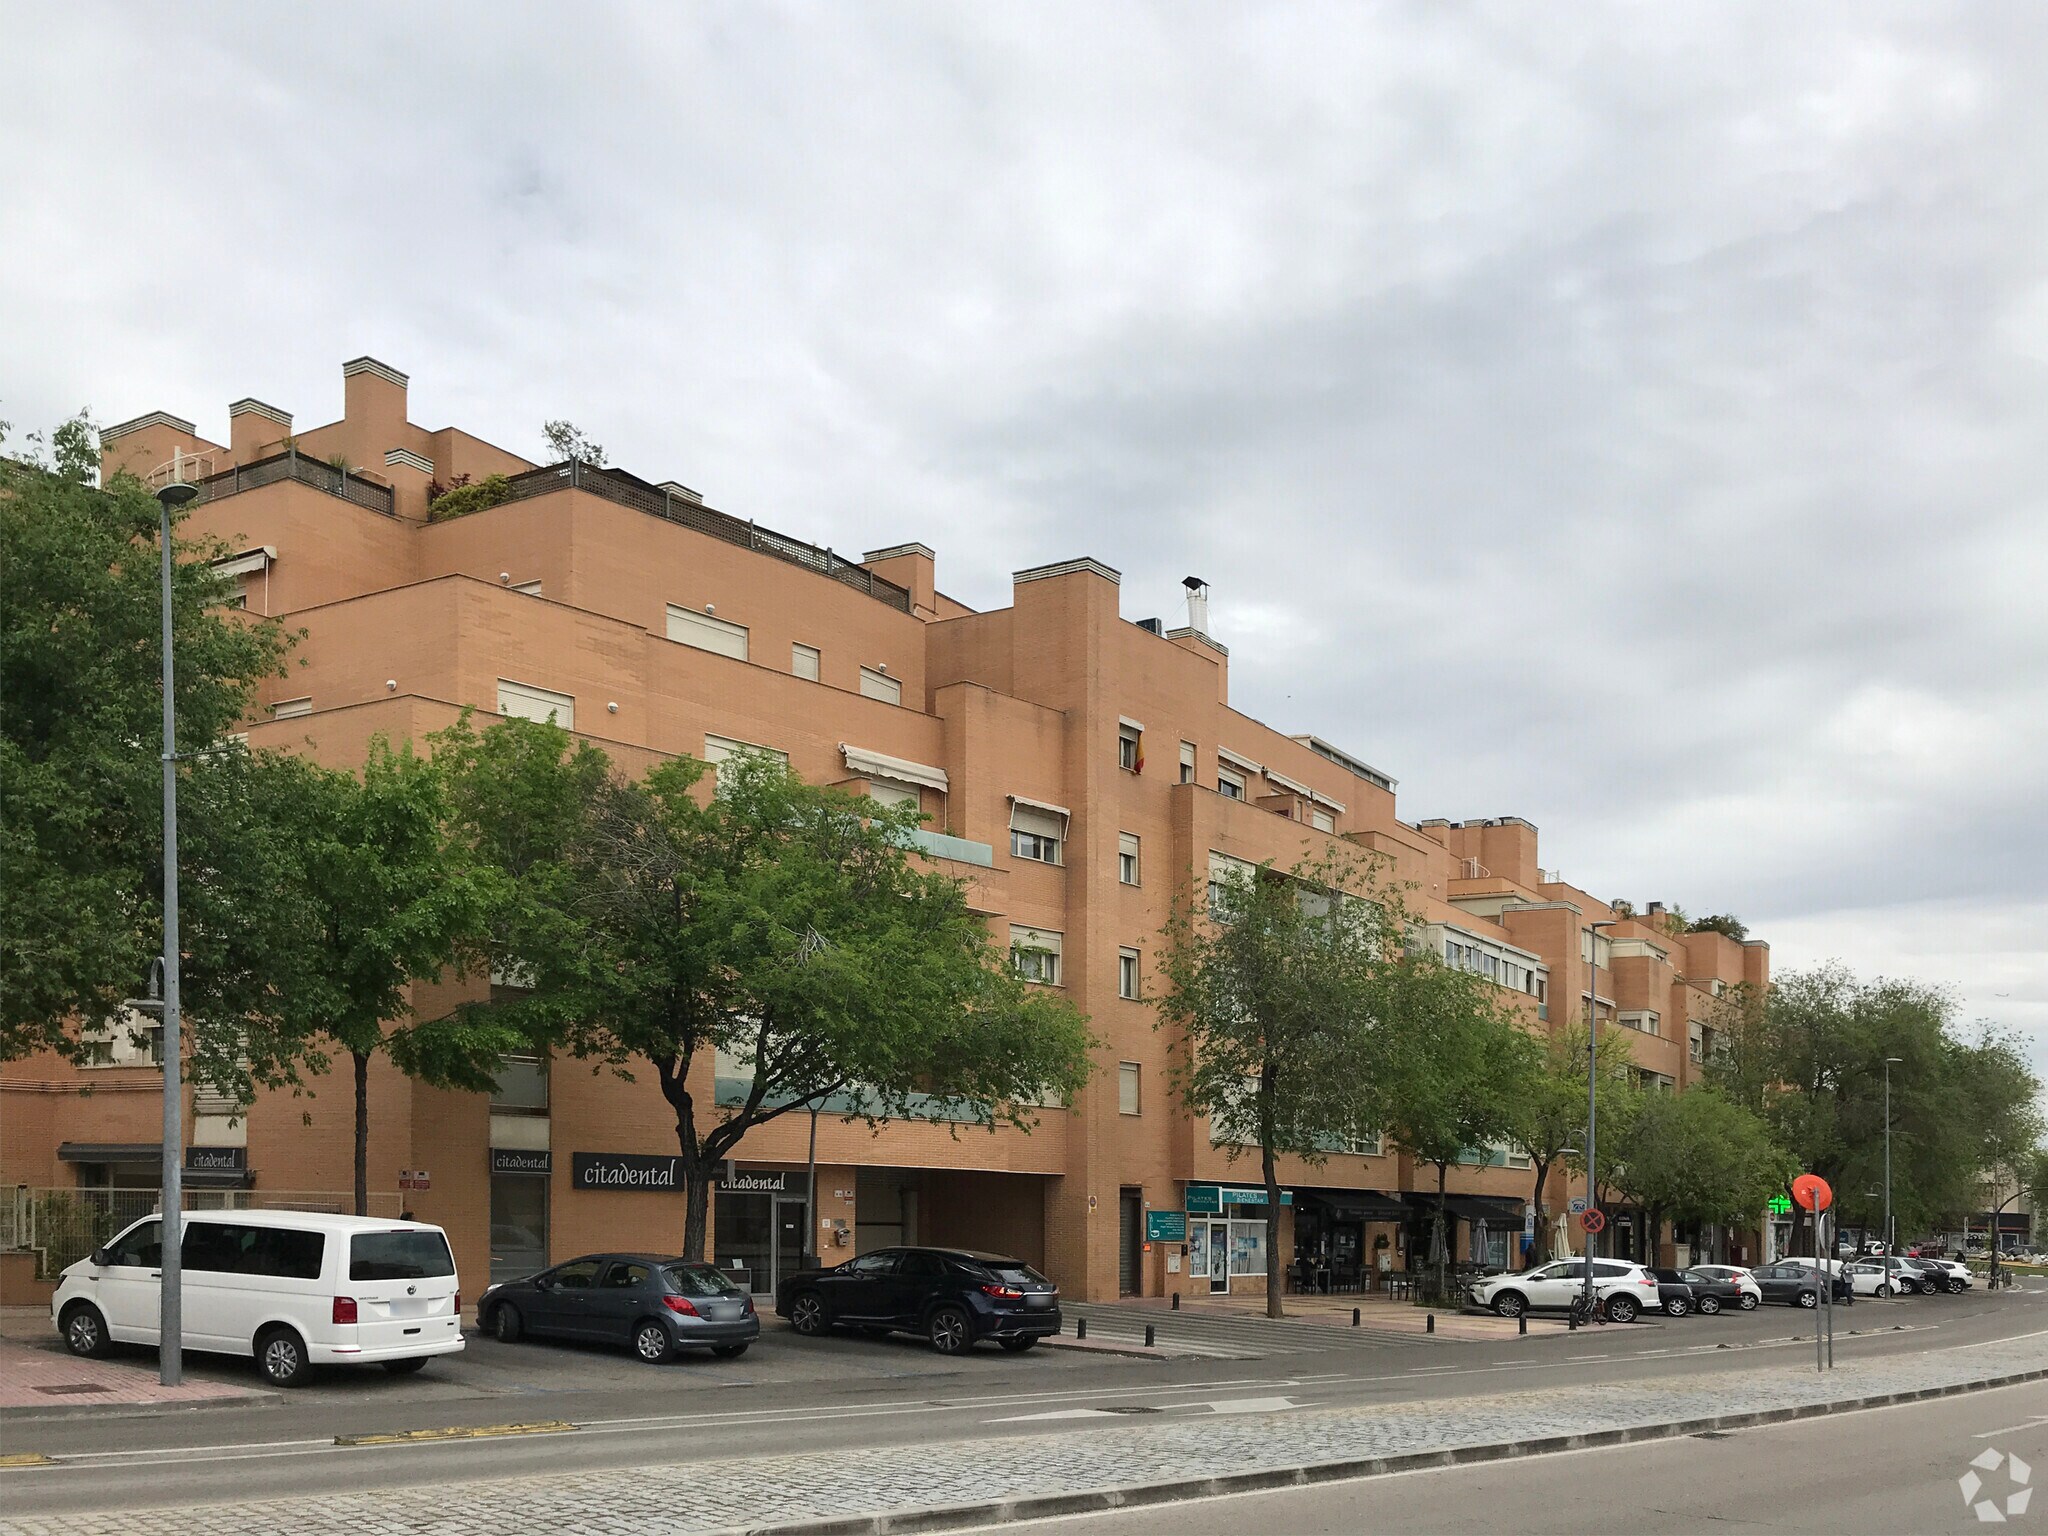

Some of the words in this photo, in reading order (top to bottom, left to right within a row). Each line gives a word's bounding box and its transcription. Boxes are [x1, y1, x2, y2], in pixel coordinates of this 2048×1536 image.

[193, 1149, 235, 1168] citadental
[496, 1154, 549, 1169] citadental
[584, 1159, 676, 1186] citadental
